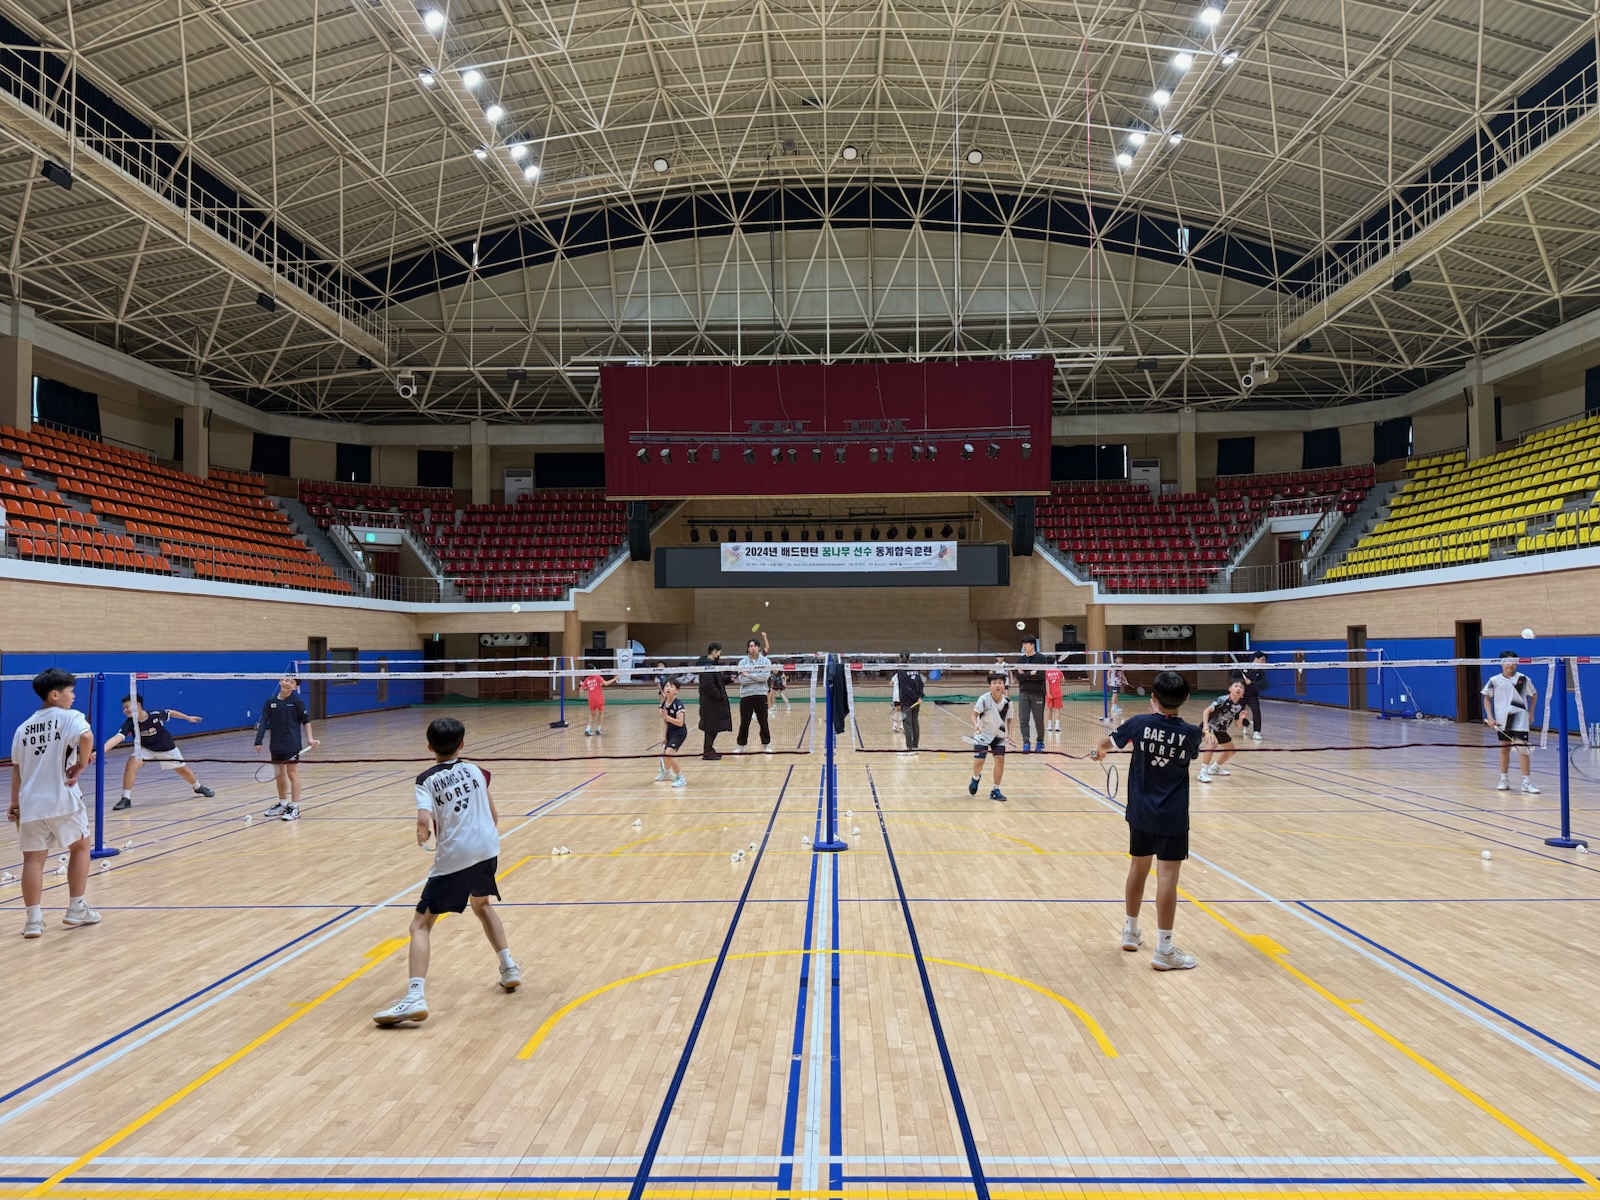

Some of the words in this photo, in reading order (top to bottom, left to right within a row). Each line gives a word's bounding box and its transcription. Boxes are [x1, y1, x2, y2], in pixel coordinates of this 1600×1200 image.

[745, 546, 777, 557] 2024년
[781, 546, 819, 557] 배드민턴
[822, 547, 850, 557] 꿈나무
[853, 546, 872, 557] 선수
[876, 546, 932, 557] 동계합숙훈련
[22, 732, 61, 746] KOREA
[1140, 741, 1186, 759] KOREA
[435, 779, 480, 806] KOREA
